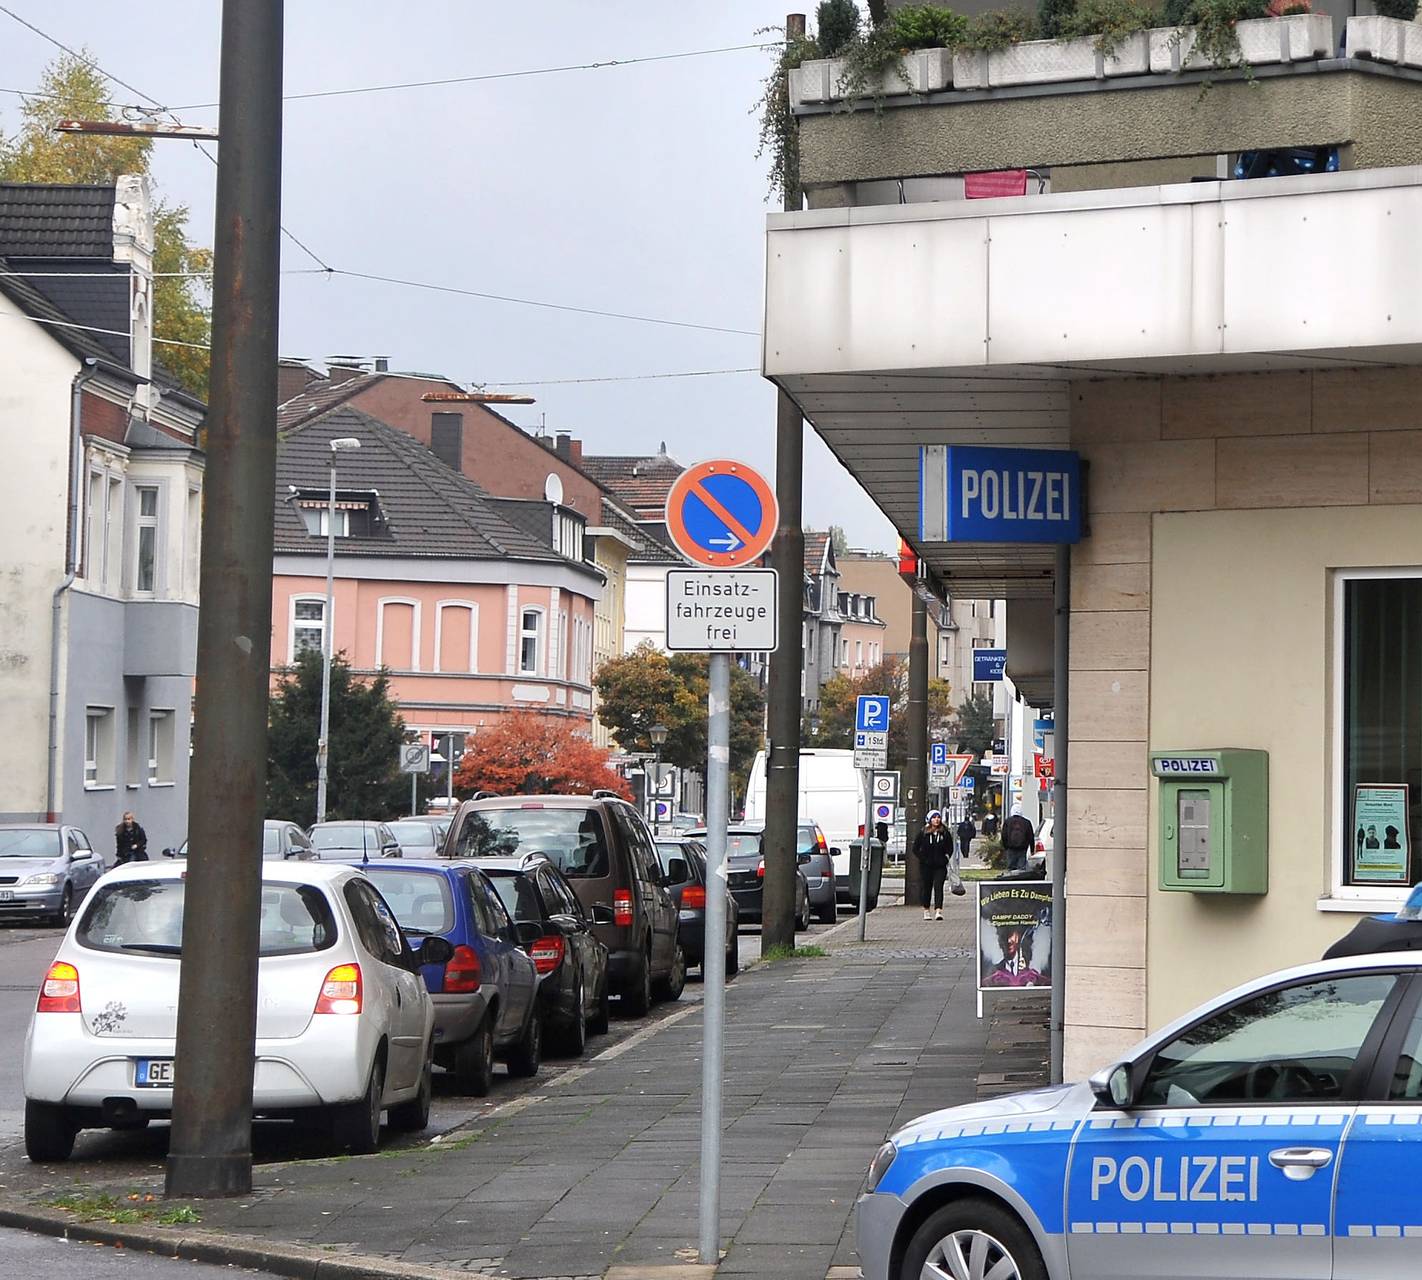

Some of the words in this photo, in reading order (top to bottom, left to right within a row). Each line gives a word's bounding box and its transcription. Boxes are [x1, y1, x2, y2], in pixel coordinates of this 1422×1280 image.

[962, 469, 1070, 521] POLIZEI
[684, 580, 759, 596] Einsatz-
[677, 602, 767, 622] fahrzeuge
[707, 624, 737, 640] frei
[864, 700, 882, 727] P
[1161, 760, 1214, 772] POLIZEI
[990, 890, 1010, 901] Lieben
[1011, 889, 1019, 898] Es
[1020, 889, 1030, 898] Zu
[149, 1063, 170, 1081] GE
[1091, 1156, 1258, 1202] POLIZEI
